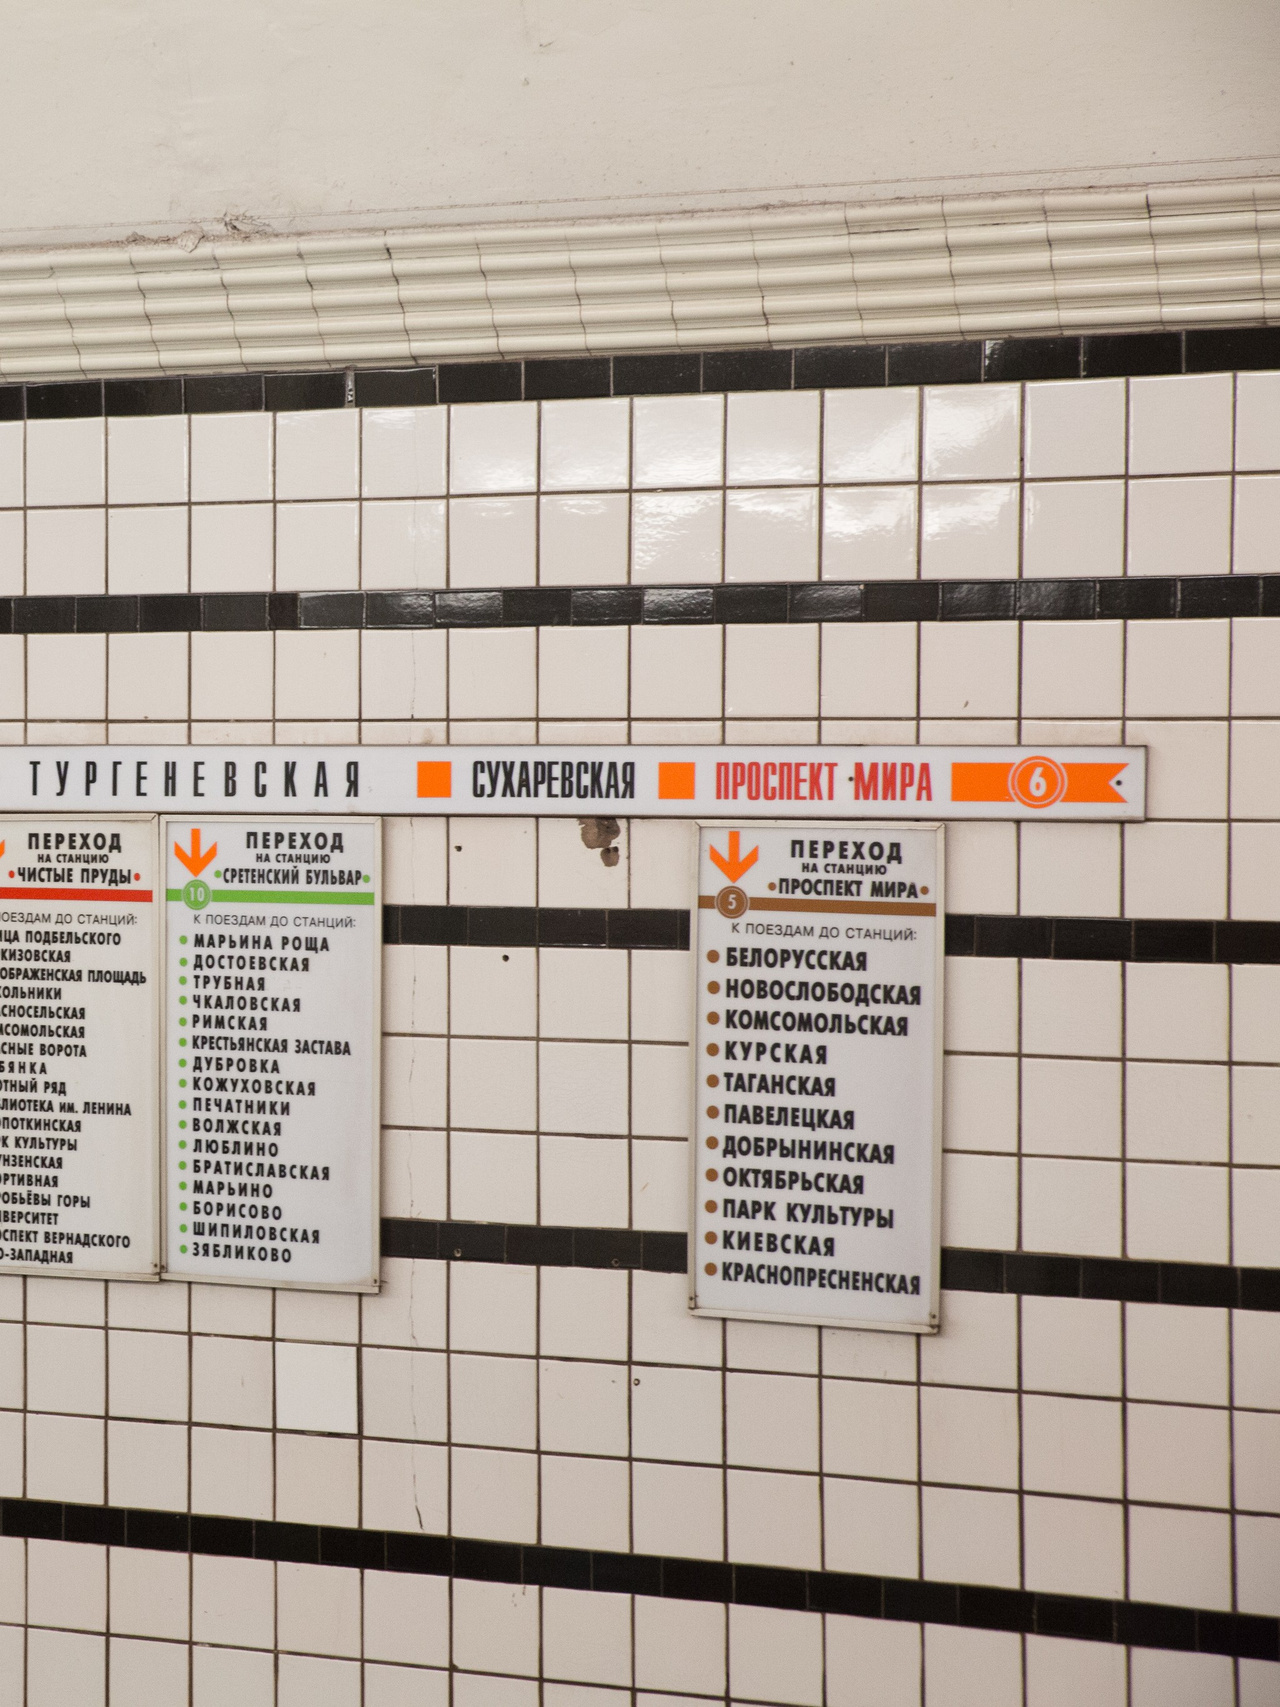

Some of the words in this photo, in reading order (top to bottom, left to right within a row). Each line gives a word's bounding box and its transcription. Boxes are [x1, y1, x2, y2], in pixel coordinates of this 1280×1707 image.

[29, 761, 359, 798] ТУРГЕНЕВСКАЯ
[472, 760, 635, 799] СУХАРЕВСКАЯ
[716, 762, 838, 801] ПРОСПЕКТ
[854, 762, 932, 801] МИРА
[1029, 767, 1048, 797] 6
[27, 832, 122, 854] ПЕРЕХОД
[246, 831, 344, 854] ПЕРЕХОД
[790, 839, 903, 865] ПЕРЕХОД
[37, 853, 52, 864] НА
[55, 853, 110, 865] СТАНЦИЮ
[255, 852, 271, 863] НА
[275, 853, 331, 866] СТАНЦИЮ
[801, 862, 819, 874] НА
[823, 862, 887, 876] СТАНЦИЮ
[17, 866, 74, 883] ЧИСТЫЕ
[80, 867, 132, 887] ПРУДЫ
[222, 865, 300, 885] СРЕТЕНСКИЙ
[305, 869, 362, 886] БУЛЬВАР
[189, 887, 205, 902] 10
[778, 877, 863, 897] ПРОСПЕКТ
[870, 880, 919, 900] МИРА
[727, 894, 737, 910] 5
[25, 930, 122, 946] ПОДБЕЛЬСКОГО
[731, 922, 740, 934] К
[745, 922, 815, 938] ПОЕЗДАМ
[818, 926, 840, 939] ДО
[193, 933, 273, 950] МАРЬИНА
[281, 935, 330, 954] РОЩА
[193, 953, 310, 972] ДОСТОЕВСКАЯ
[726, 946, 868, 972] БЕЛОРУССКАЯ
[193, 974, 265, 992] ТРУБНАЯ
[725, 978, 922, 1008] НОВОСЛОБОДСКАЯ
[192, 1013, 268, 1032] РИМСКАЯ
[725, 1008, 909, 1037] КОМСОМОЛЬСКАЯ
[39, 1043, 88, 1058] ВОРОТА
[192, 1034, 288, 1054] КРЕСТЬЯНСКАЯ
[294, 1038, 352, 1056] ЗАСТАВА
[724, 1040, 827, 1065] КУРСКАЯ
[192, 1055, 280, 1074] ДУБРОВКА
[43, 1080, 67, 1097] РЯД
[723, 1071, 836, 1098] ТАГАНСКАЯ
[82, 1101, 132, 1117] ЛЕНИНА
[192, 1096, 290, 1116] ПЕЧАТНИКИ
[192, 1117, 282, 1137] ВОЛЖСКАЯ
[724, 1103, 855, 1132] ПАВЕЛЕЦКАЯ
[14, 1135, 78, 1152] КУЛЬТУРЫ
[192, 1138, 279, 1158] ЛЮБЛИНО
[722, 1134, 895, 1165] ДОБРЫНИНСКАЯ
[192, 1179, 273, 1199] МАРЬИНО
[722, 1166, 864, 1195] ОКТЯБРЬСКАЯ
[57, 1194, 91, 1209] ГОРЫ
[192, 1200, 283, 1221] БОРИСОВО
[722, 1198, 777, 1222] ПАРК
[786, 1202, 894, 1229] КУЛЬТУРЫ
[43, 1230, 131, 1249] ВЕРНАДСКОГО
[192, 1221, 320, 1245] ШИПИЛОВСКАЯ
[722, 1229, 835, 1258] КИЕВСКАЯ
[192, 1241, 292, 1264] ЗЯБЛИКОВО
[721, 1261, 921, 1296] КРАСНОПРЕСНЕНСКАЯ
